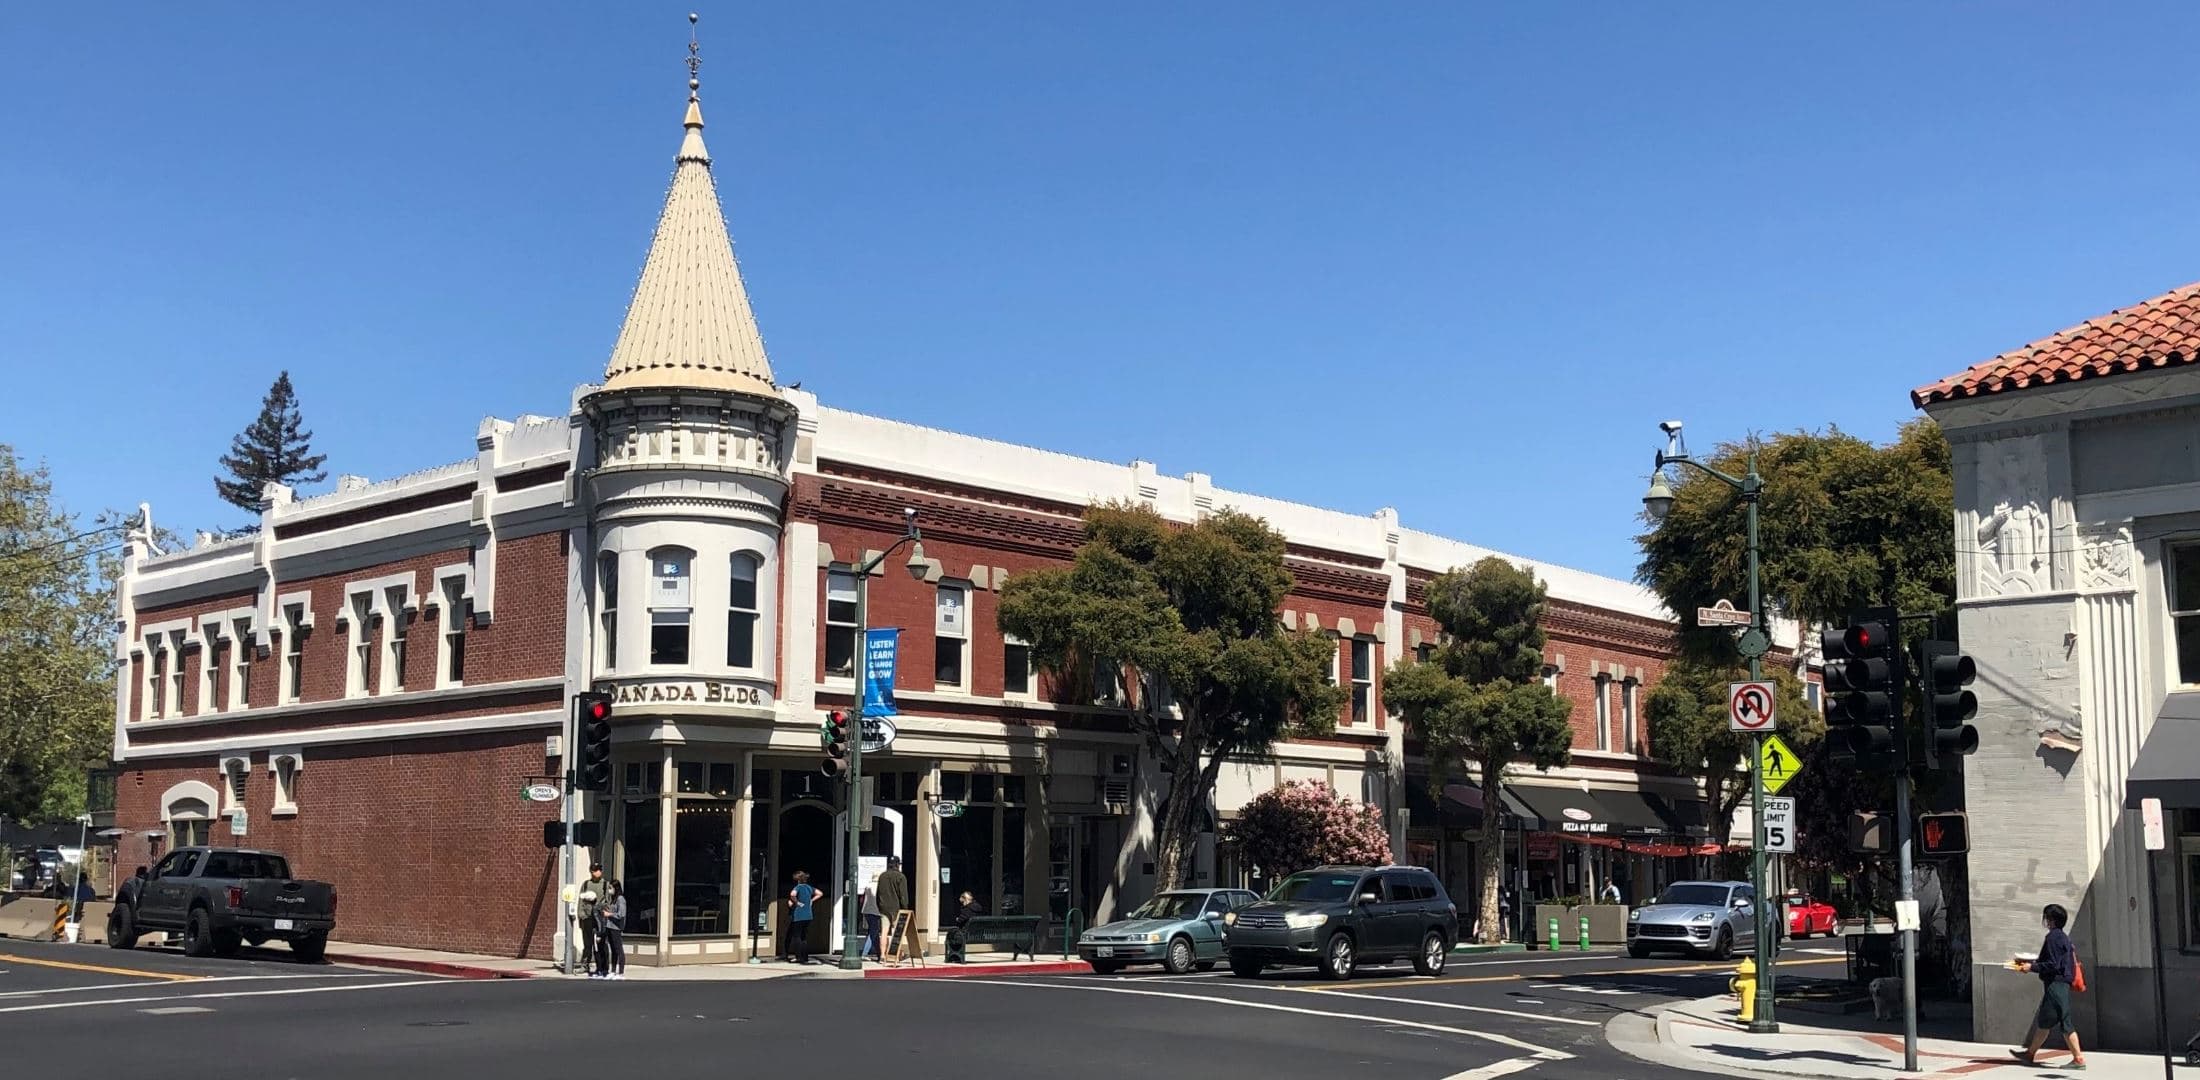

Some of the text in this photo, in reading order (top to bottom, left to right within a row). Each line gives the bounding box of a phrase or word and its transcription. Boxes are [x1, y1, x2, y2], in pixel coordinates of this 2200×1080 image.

[869, 640, 894, 649] LISTEN
[869, 651, 894, 660] LEARN
[1764, 801, 1790, 811] PEED
[1562, 822, 1579, 832] PIZZA
[1590, 823, 1608, 832] HEART
[1764, 827, 1785, 847] 15
